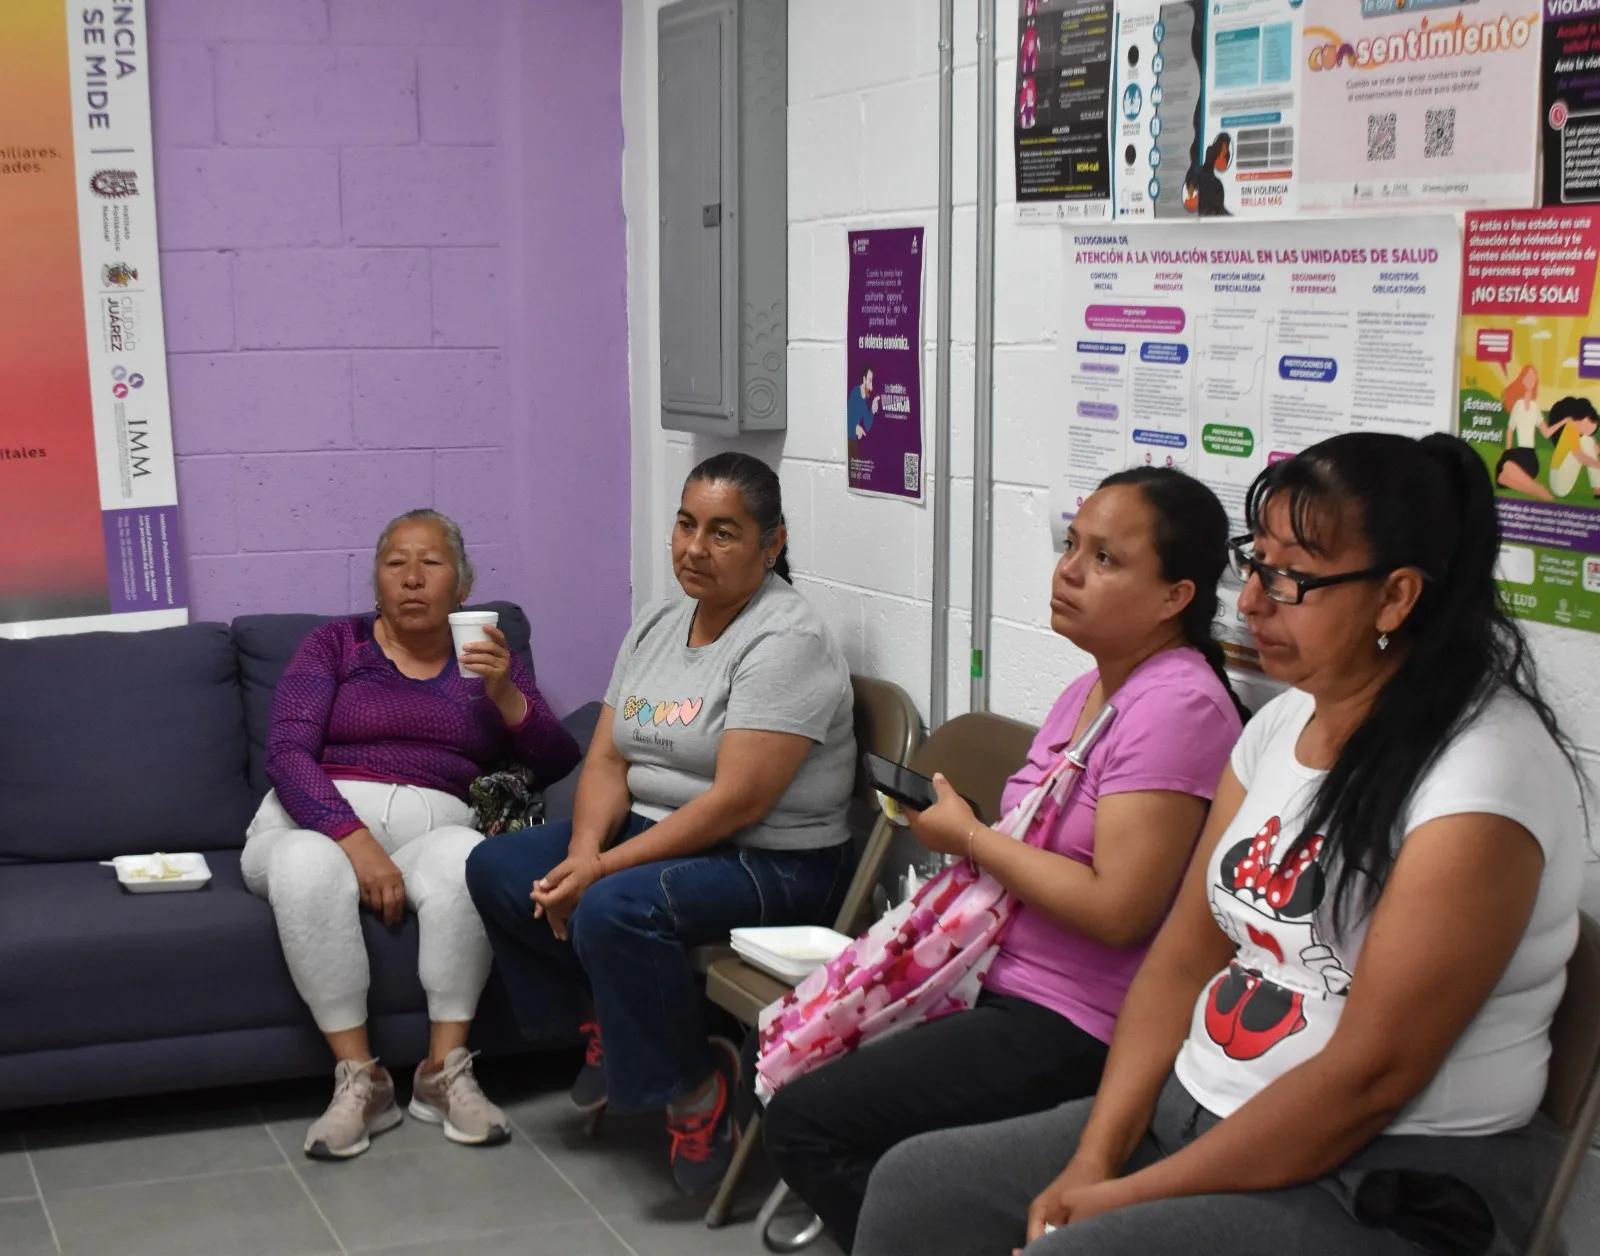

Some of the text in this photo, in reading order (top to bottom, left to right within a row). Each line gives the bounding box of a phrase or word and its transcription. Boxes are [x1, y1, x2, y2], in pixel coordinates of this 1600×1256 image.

[1308, 12, 1530, 72] consentimiento
[83, 9, 110, 130] SE MIDE
[0, 161, 44, 174] ades.
[1470, 219, 1478, 232] Si
[1479, 219, 1501, 231] estás
[1511, 217, 1526, 230] has
[1528, 216, 1558, 230] estado
[1560, 220, 1571, 229] en
[1574, 218, 1592, 228] una
[1509, 234, 1521, 245] de
[1523, 232, 1563, 245] violencia
[1075, 248, 1439, 264] ATENCIÓN A LA VIOLACIÓN SEXUAL EN LAS UNIDADES DE SALUD
[1584, 246, 1596, 260] de
[1481, 266, 1521, 279] personas
[1522, 266, 1540, 279] que
[1541, 263, 1576, 279] quieres
[1472, 280, 1580, 306] ¡NO ESTÁS SOLA!
[108, 298, 123, 352] JUÁREZ
[121, 296, 136, 352] CIUDAD
[859, 336, 864, 348] es
[864, 333, 883, 349] violencia
[1472, 415, 1492, 427] para
[128, 420, 153, 479] IMM
[654, 732, 674, 752] happy
